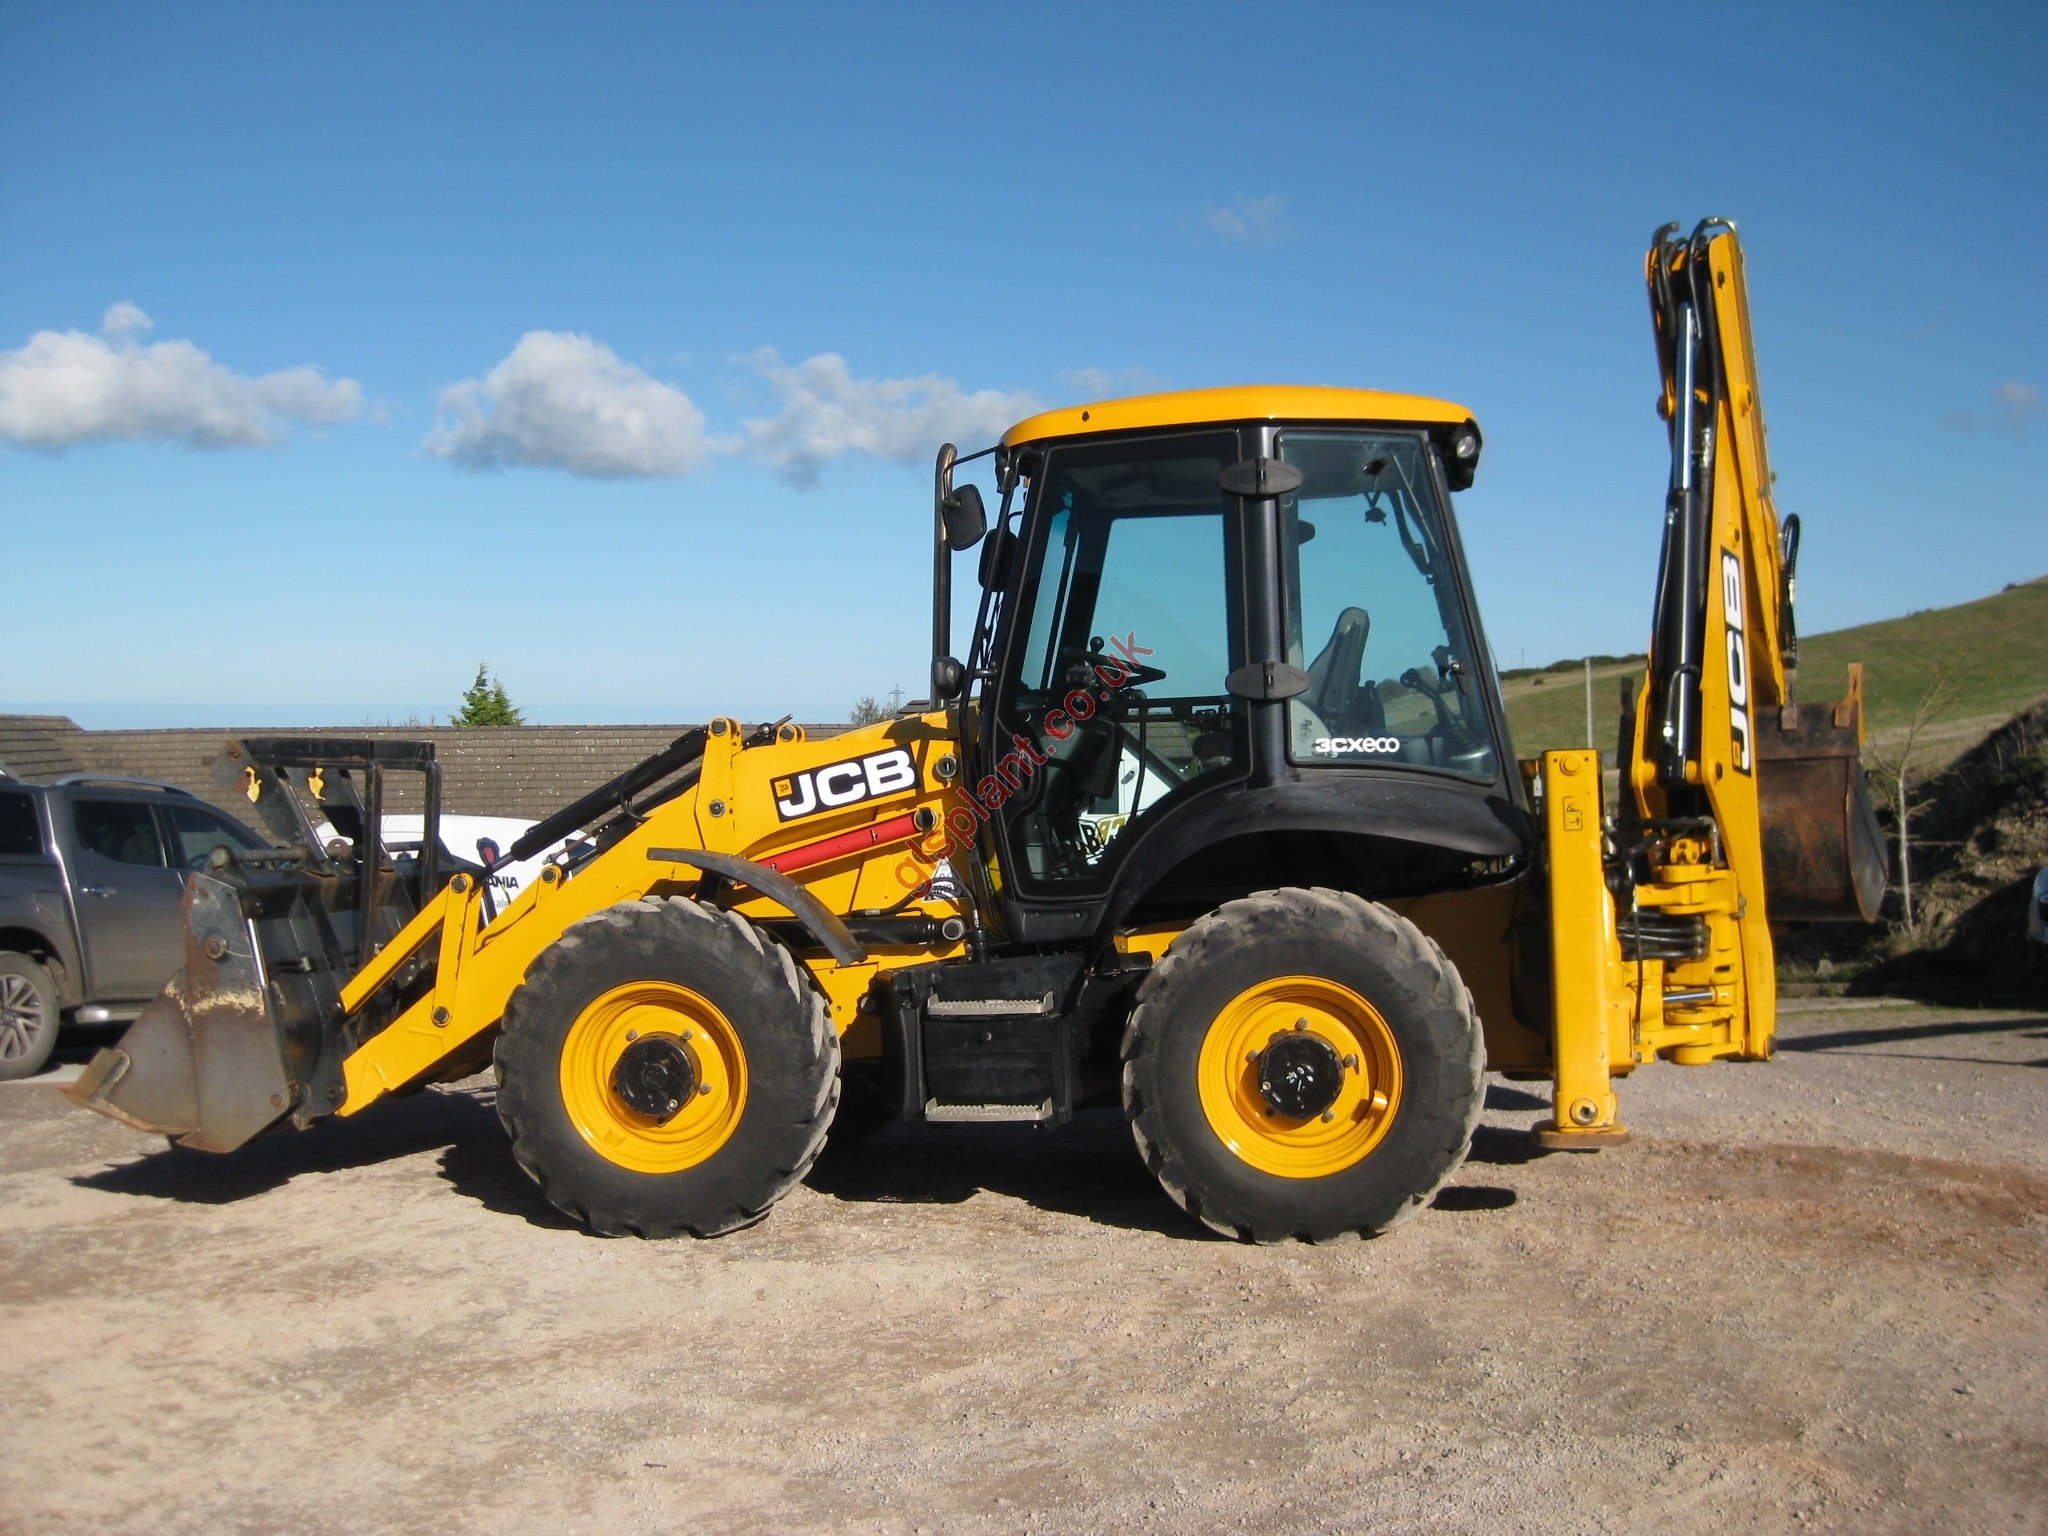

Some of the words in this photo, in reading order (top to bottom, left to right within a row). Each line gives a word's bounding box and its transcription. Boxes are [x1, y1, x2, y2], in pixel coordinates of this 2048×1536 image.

[1722, 554, 1750, 771] JCB
[778, 749, 916, 817] JCB
[486, 875, 520, 889] ANIA
